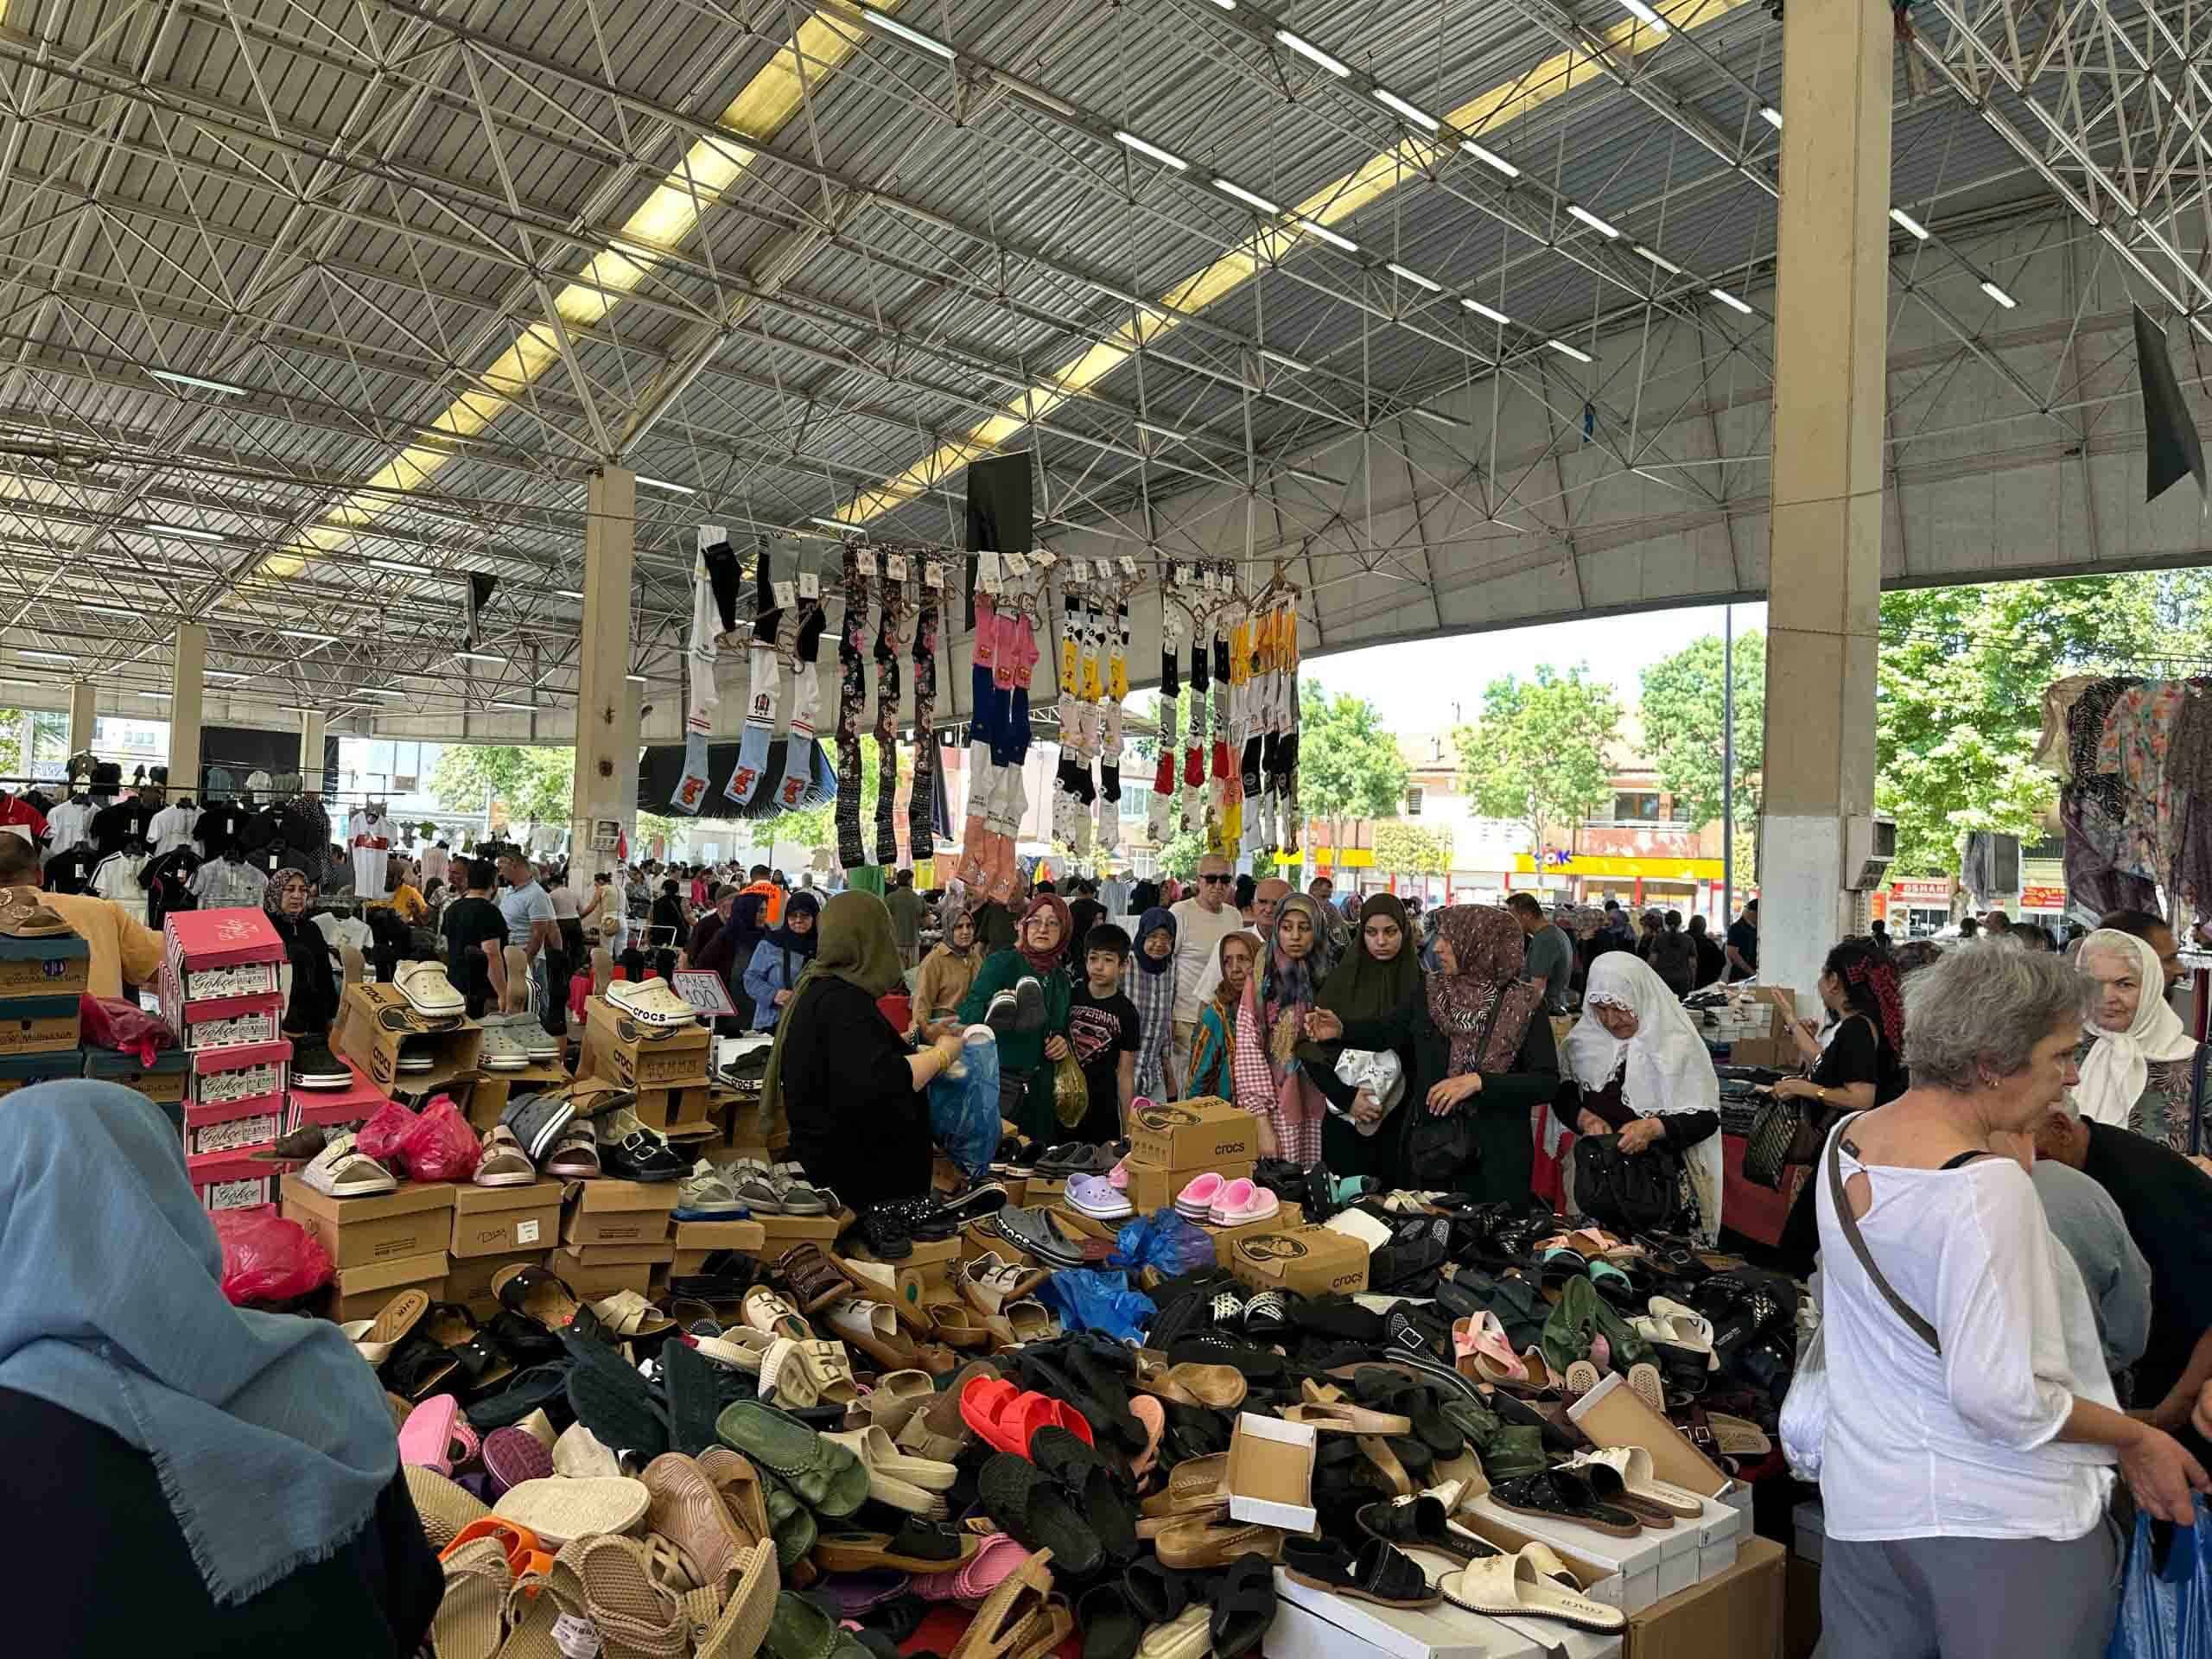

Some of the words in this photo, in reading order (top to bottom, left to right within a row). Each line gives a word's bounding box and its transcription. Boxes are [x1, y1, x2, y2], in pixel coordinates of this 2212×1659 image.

[632, 1007, 666, 1022] crocs
[731, 1078, 754, 1089] crocs
[1215, 1141, 1245, 1155] crocs
[1332, 1271, 1363, 1288] crocs
